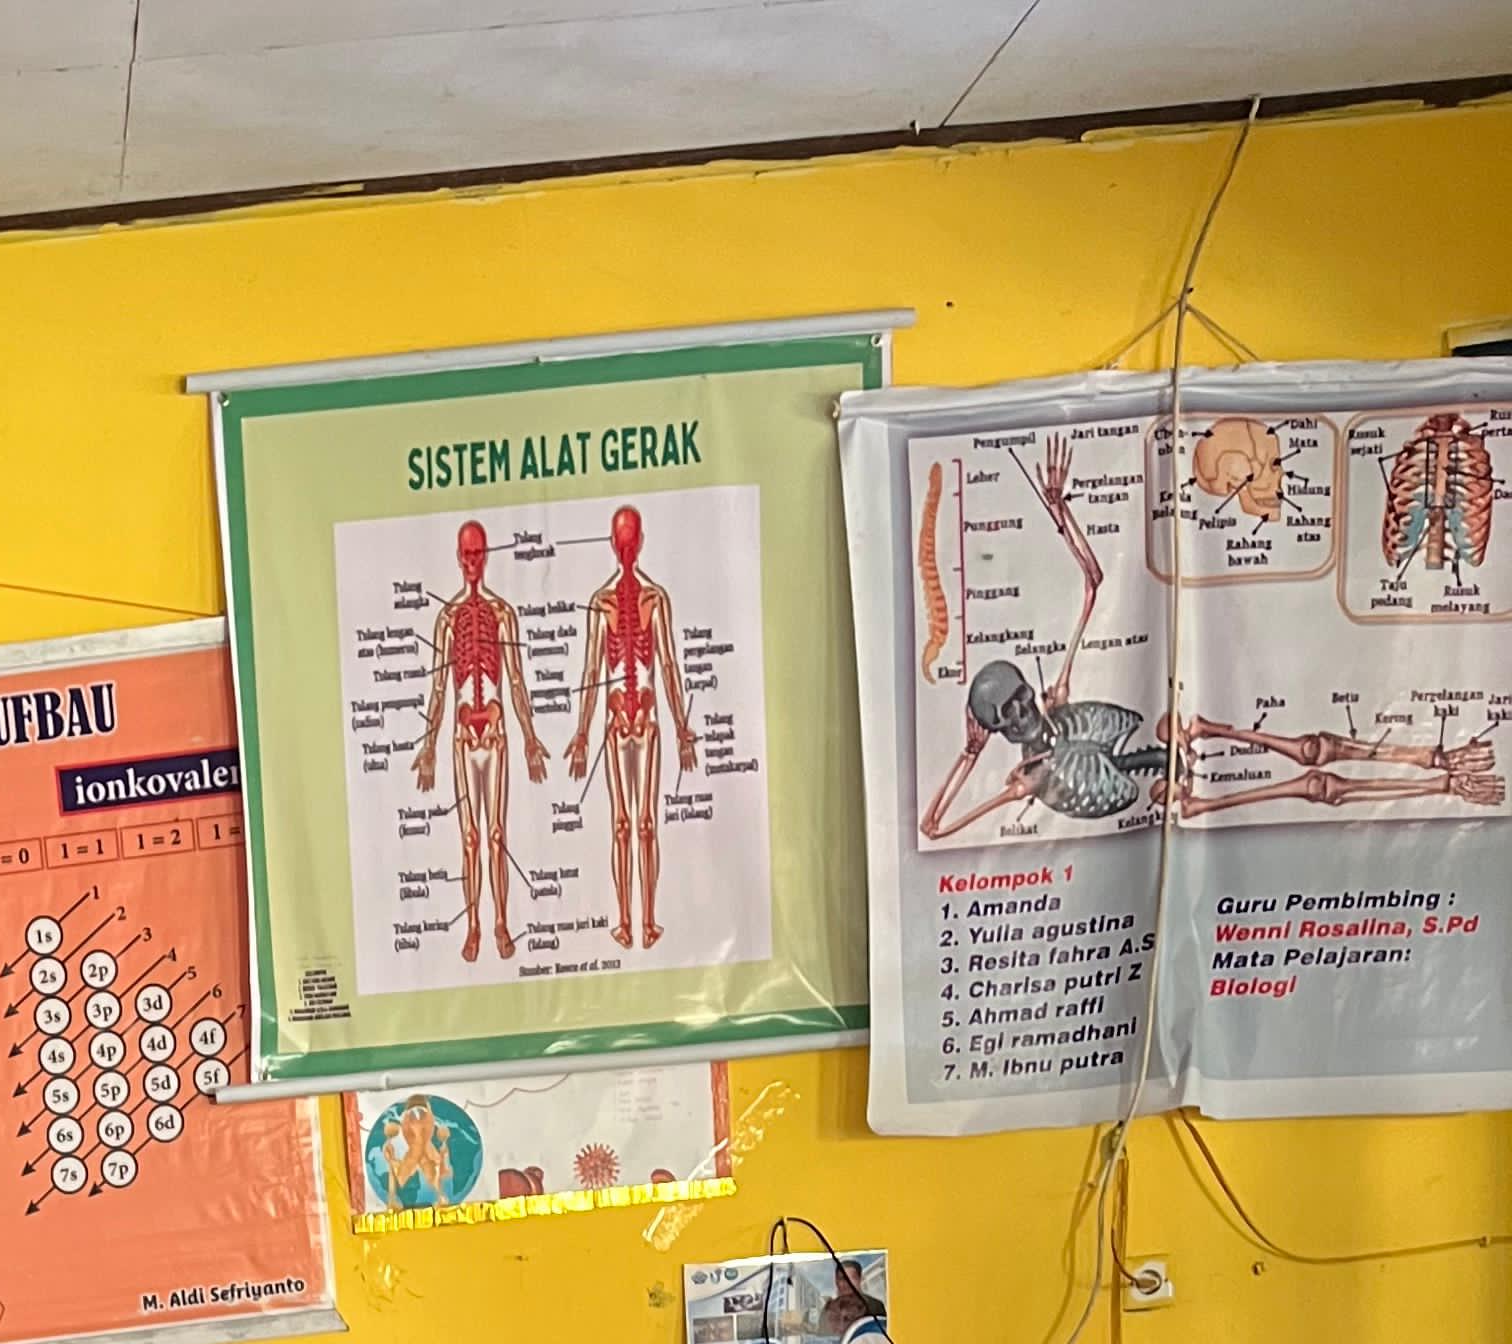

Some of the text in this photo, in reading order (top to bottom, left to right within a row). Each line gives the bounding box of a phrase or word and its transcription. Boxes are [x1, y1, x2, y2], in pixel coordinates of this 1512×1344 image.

[1071, 424, 1139, 440] Jari tangan
[1291, 418, 1317, 430] Dahi
[974, 431, 1036, 449] Pengumpil
[1289, 437, 1318, 449] Mata
[408, 421, 702, 490] SISTEM ALAT GERAK
[966, 471, 1000, 484] Leher
[1072, 473, 1144, 489] Pergelangan
[1088, 491, 1129, 504] tangan
[964, 517, 1023, 532] Punggung
[1087, 524, 1120, 536] Hasta
[1287, 516, 1331, 529] Rahang
[1226, 538, 1272, 551] Rahang
[1228, 553, 1268, 566] bawah
[966, 585, 1020, 600] Pinggang
[967, 629, 1034, 645] Kelangkang
[1081, 638, 1122, 651] Lengan
[1256, 697, 1286, 710] Paha
[1209, 768, 1272, 783] Kemaluan
[170, 829, 181, 846] 2
[96, 838, 104, 854] 1
[19, 848, 29, 864] 0
[939, 864, 1074, 893] Kelompok 1
[941, 893, 1062, 920] 1. Amanda
[1216, 896, 1277, 915] Guru
[1285, 890, 1441, 911] Pembimbing
[116, 906, 126, 921] 2
[36, 929, 53, 944] 1s
[142, 927, 152, 942] 3
[939, 913, 1135, 947] 2. Yulia agustina
[1215, 915, 1479, 943] Wenni Rosalina, S.Pd
[940, 932, 1156, 974] 3. Resita fahra A.S
[1211, 946, 1412, 970] Mata Pelajaran:
[39, 970, 57, 984] 2s
[88, 964, 108, 982] 2p
[187, 966, 197, 980] 5
[940, 962, 1143, 1000] 4. Charisa putri Z
[212, 984, 222, 999] 6
[1210, 975, 1297, 999] Biologi
[143, 994, 163, 1012] 3d
[941, 995, 1105, 1027] 5. Ahmad raffi
[44, 1010, 61, 1024] 3s
[92, 1003, 113, 1022] 3p
[236, 1004, 246, 1019] 7
[147, 1035, 167, 1052] 4d
[199, 1028, 216, 1045] 4f
[941, 1016, 1138, 1056] 6. Egi ramadhani
[48, 1050, 65, 1064] 4s
[96, 1044, 117, 1061] 4p
[943, 1050, 1124, 1080] 7. M. Ibnu putra
[151, 1074, 171, 1092] 5d
[203, 1068, 221, 1085] 5f
[52, 1089, 70, 1104] 5s
[100, 1083, 121, 1101] 5p
[104, 1122, 125, 1140] 6p
[154, 1114, 175, 1132] 6d
[56, 1128, 74, 1143] 6s
[60, 1168, 78, 1182] 7s
[108, 1162, 129, 1180] 7p
[142, 1278, 306, 1311] M. Aldi Sefriyanto
